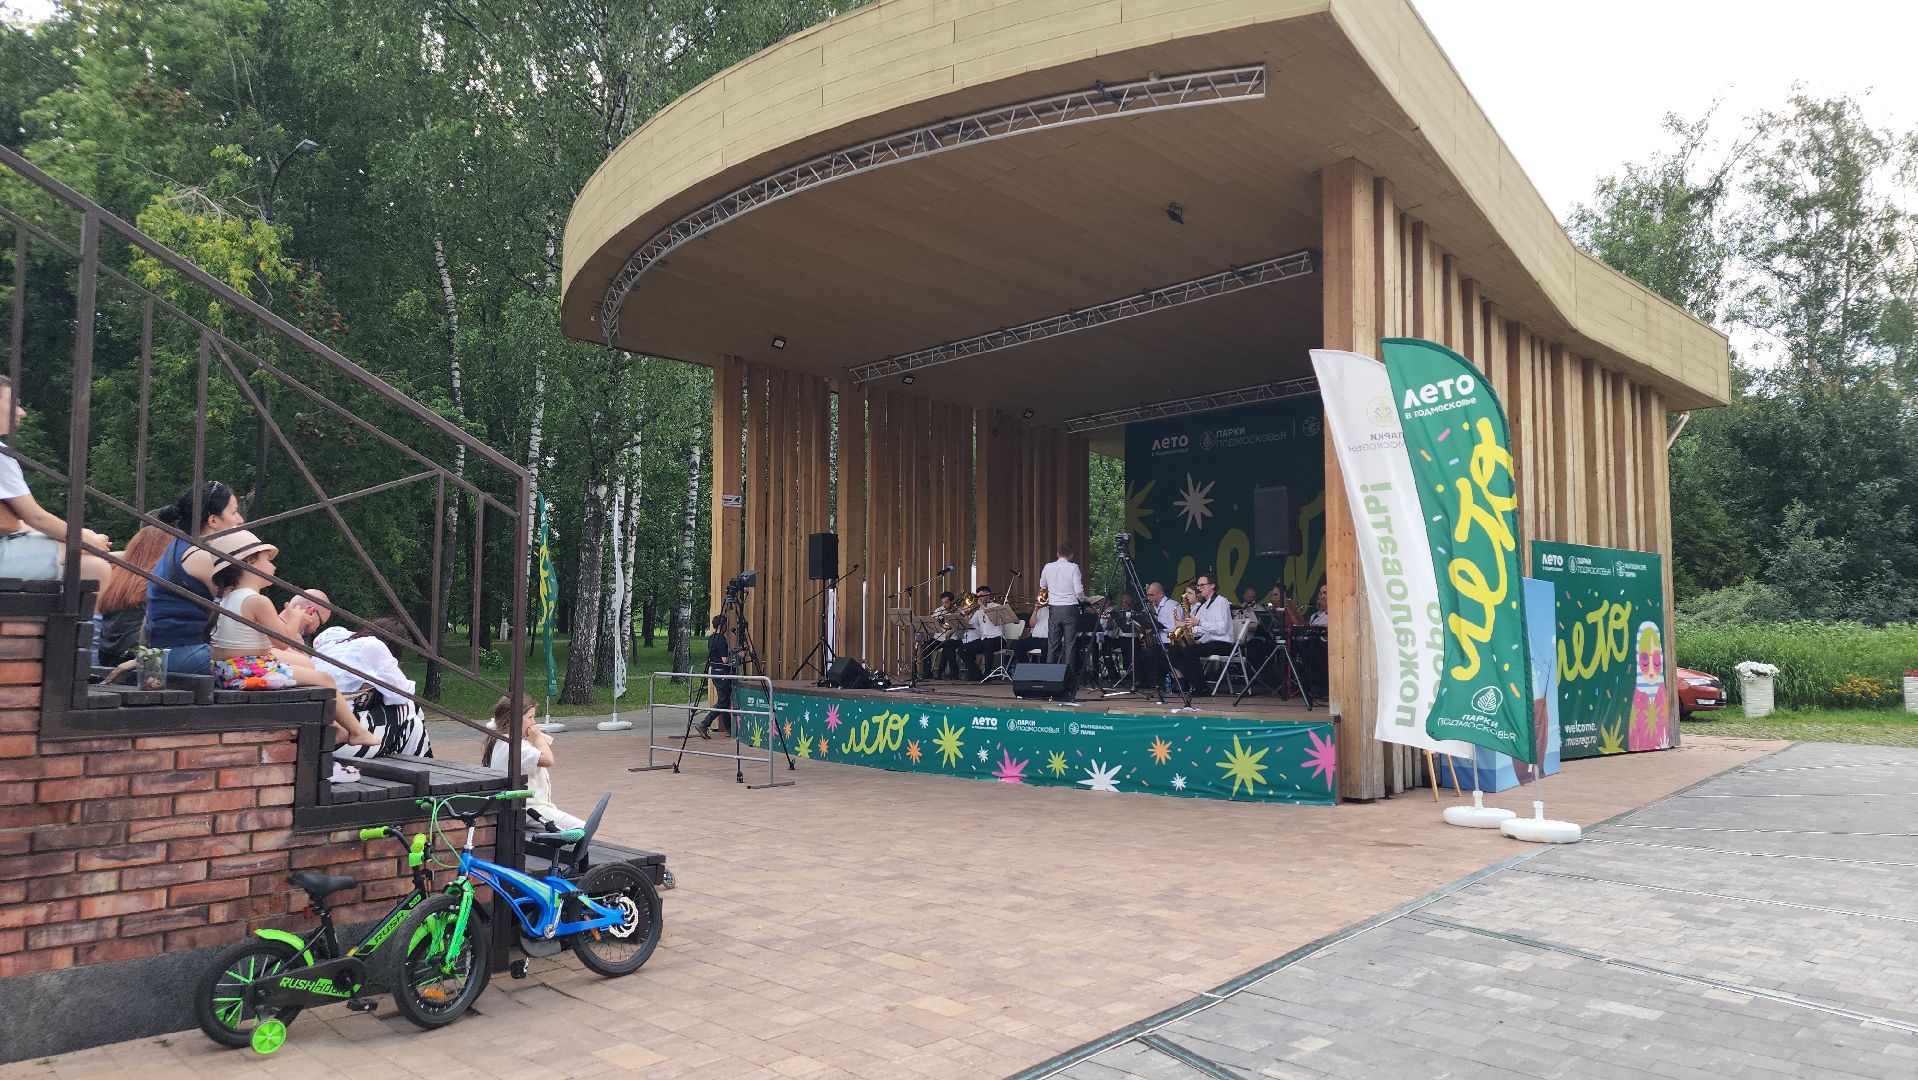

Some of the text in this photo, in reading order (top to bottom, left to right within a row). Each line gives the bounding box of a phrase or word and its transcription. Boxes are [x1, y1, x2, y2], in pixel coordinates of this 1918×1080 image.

[1216, 427, 1246, 439] ПАРКИ
[1437, 717, 1517, 742] ПОДМОСКОВЬЯ
[1462, 714, 1499, 729] ПАРКИ
[374, 912, 405, 944] RUSH
[279, 976, 316, 992] RUSH
